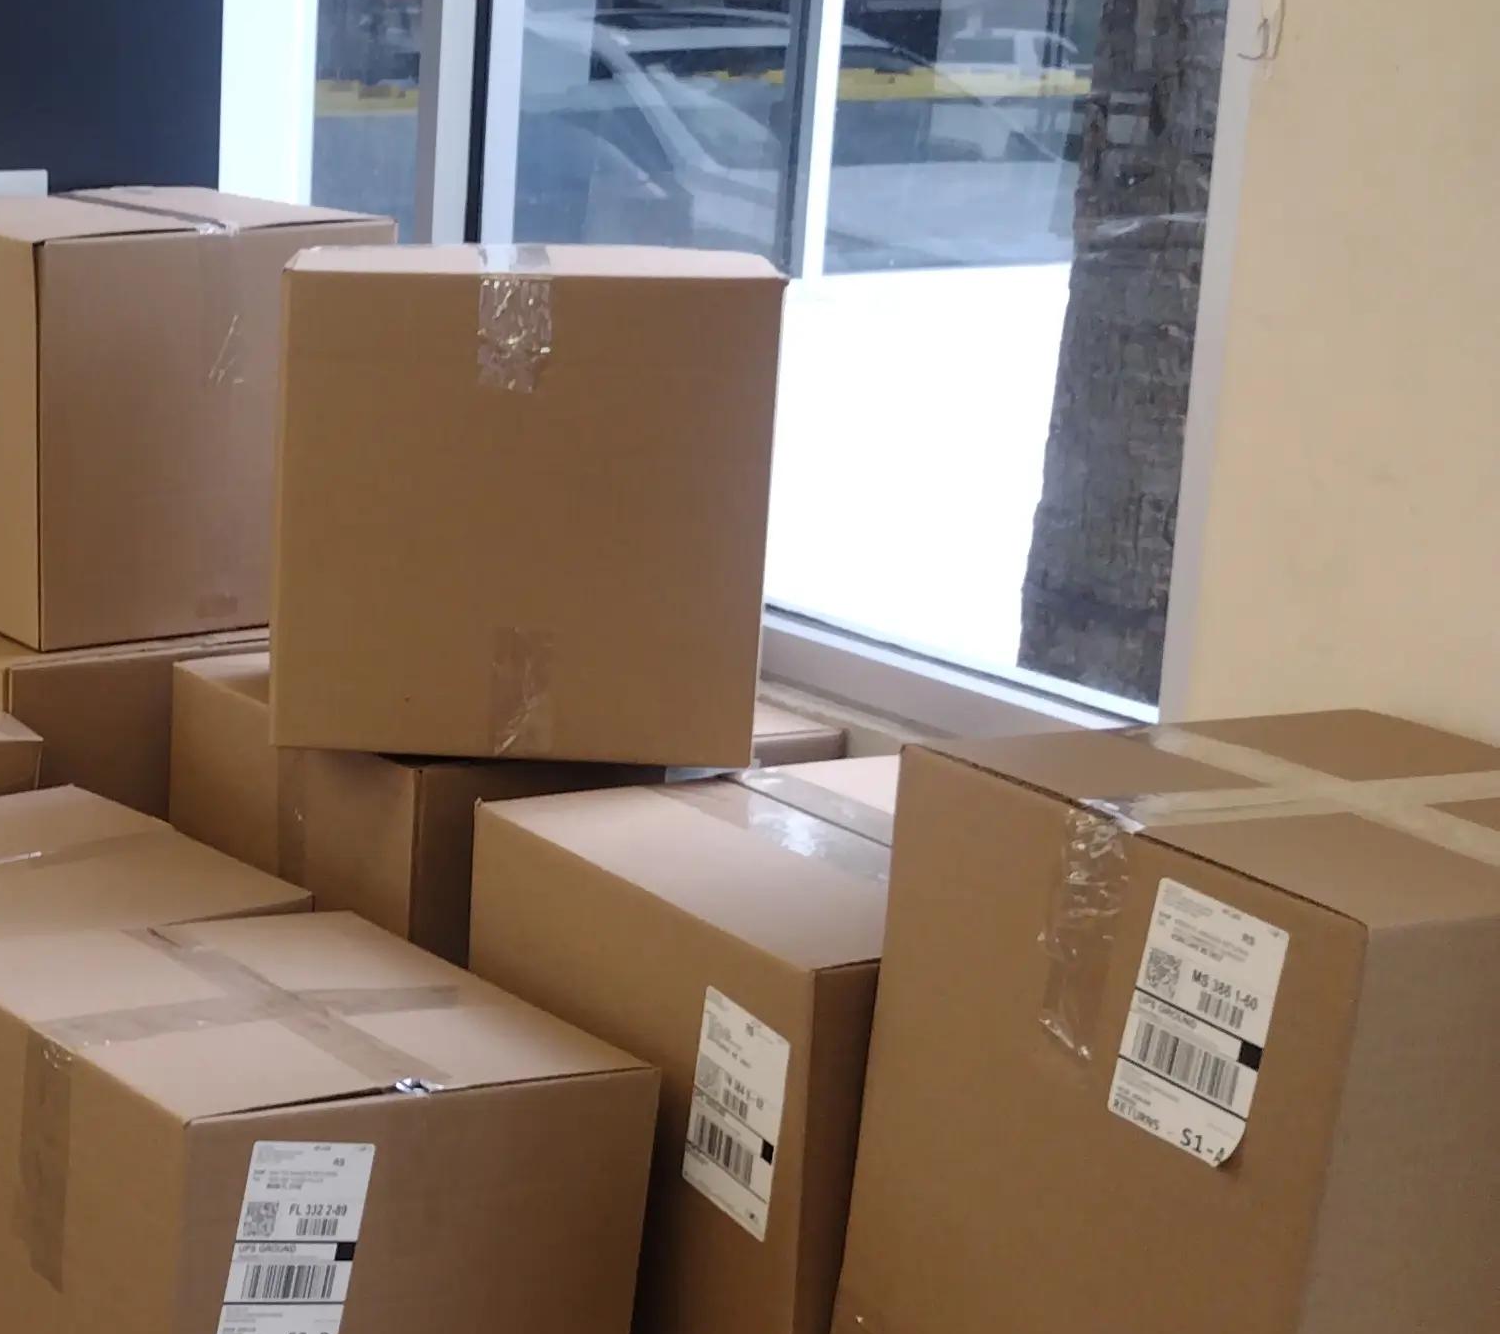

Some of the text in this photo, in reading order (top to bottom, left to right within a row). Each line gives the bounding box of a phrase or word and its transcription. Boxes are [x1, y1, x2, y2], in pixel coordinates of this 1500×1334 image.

[1112, 1098, 1161, 1132] RETURNS
[1179, 1127, 1226, 1164] S1-A
[288, 1203, 303, 1217] FL
[258, 1242, 297, 1254] GROUND
